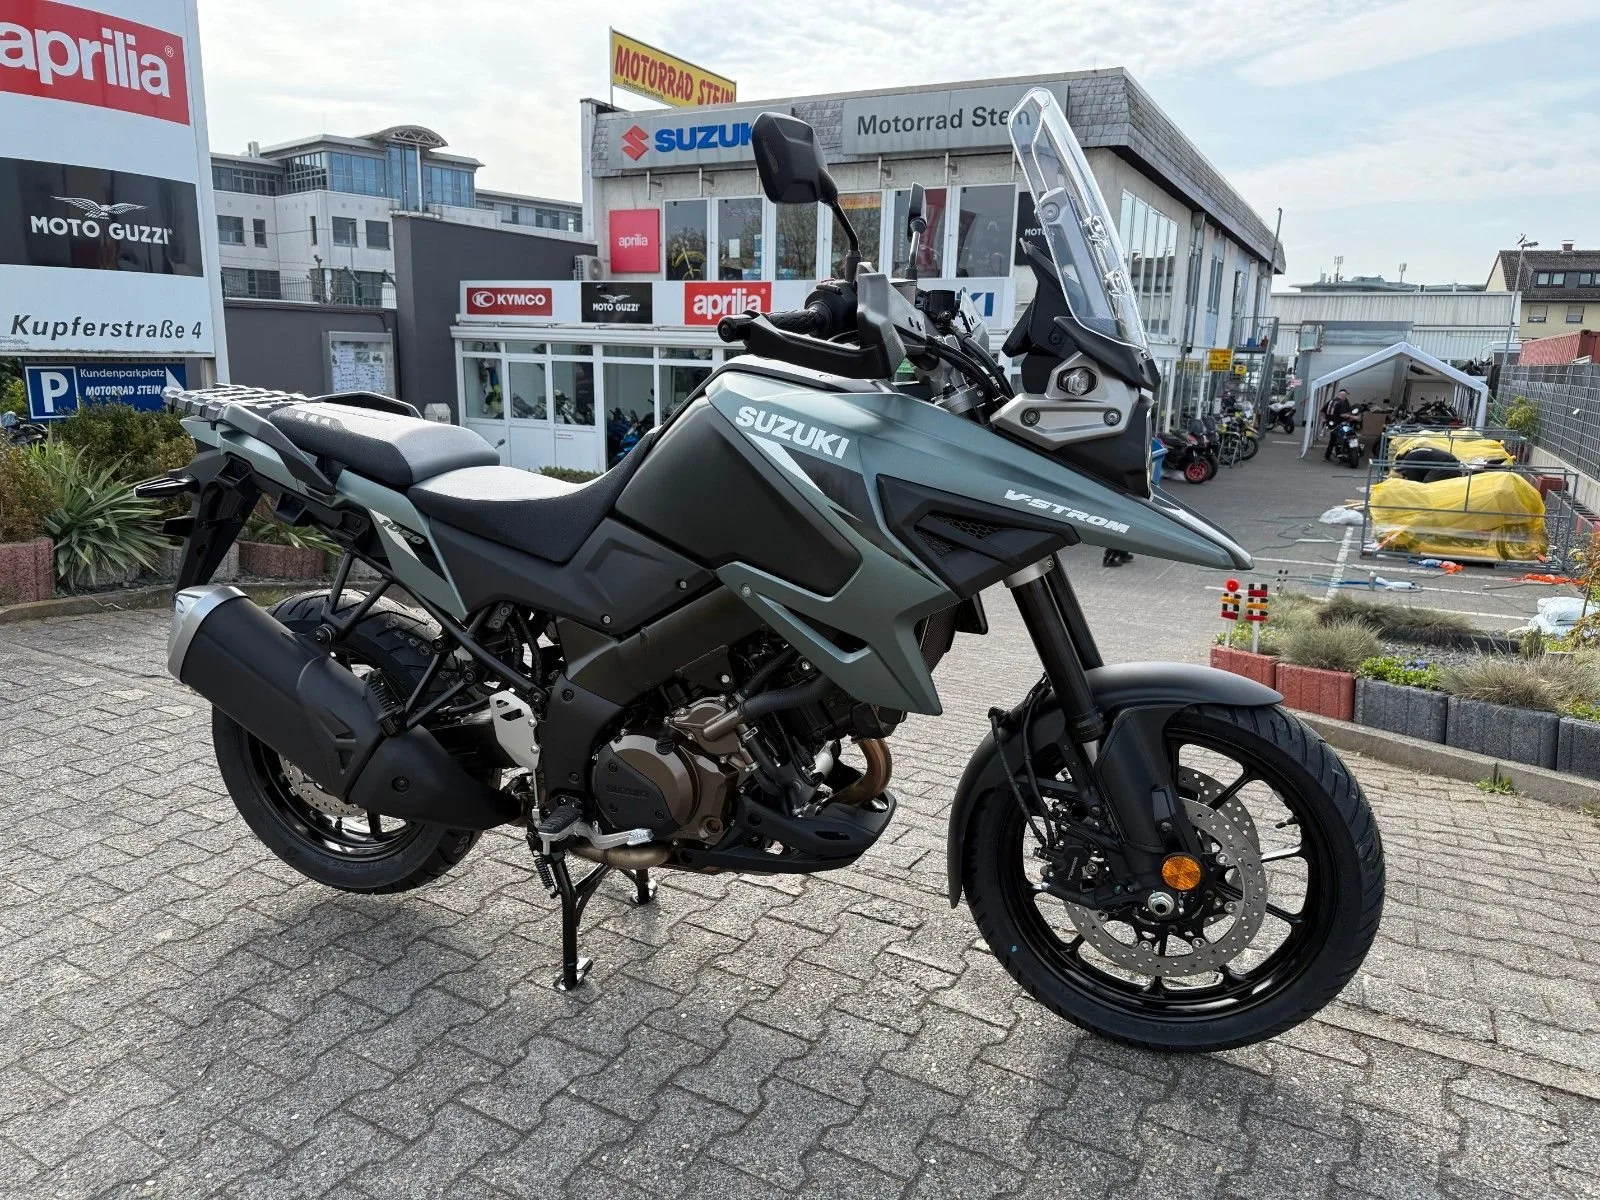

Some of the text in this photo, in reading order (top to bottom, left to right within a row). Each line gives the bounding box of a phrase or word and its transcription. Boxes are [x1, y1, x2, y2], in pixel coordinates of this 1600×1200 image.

[0, 22, 170, 98] aprilia
[614, 44, 734, 105] MOTORRAD STEIN
[857, 105, 1031, 136] Motorrad Sten
[655, 122, 753, 153] SUZUK
[30, 215, 169, 245] MOTO GUZZI
[618, 233, 648, 249] aprilia
[497, 294, 546, 307] KYMCO
[592, 302, 639, 312] MOTO GUZZI
[693, 288, 762, 321] aprilia
[11, 314, 202, 341] Kupferstraße 4
[80, 368, 165, 379] Kundenparkplatz
[40, 371, 69, 413] P
[85, 385, 161, 396] MOTORRAD STEIN
[735, 406, 850, 460] SUZUKI
[1004, 489, 1131, 534] V-STROM
[381, 519, 425, 545] 1050
